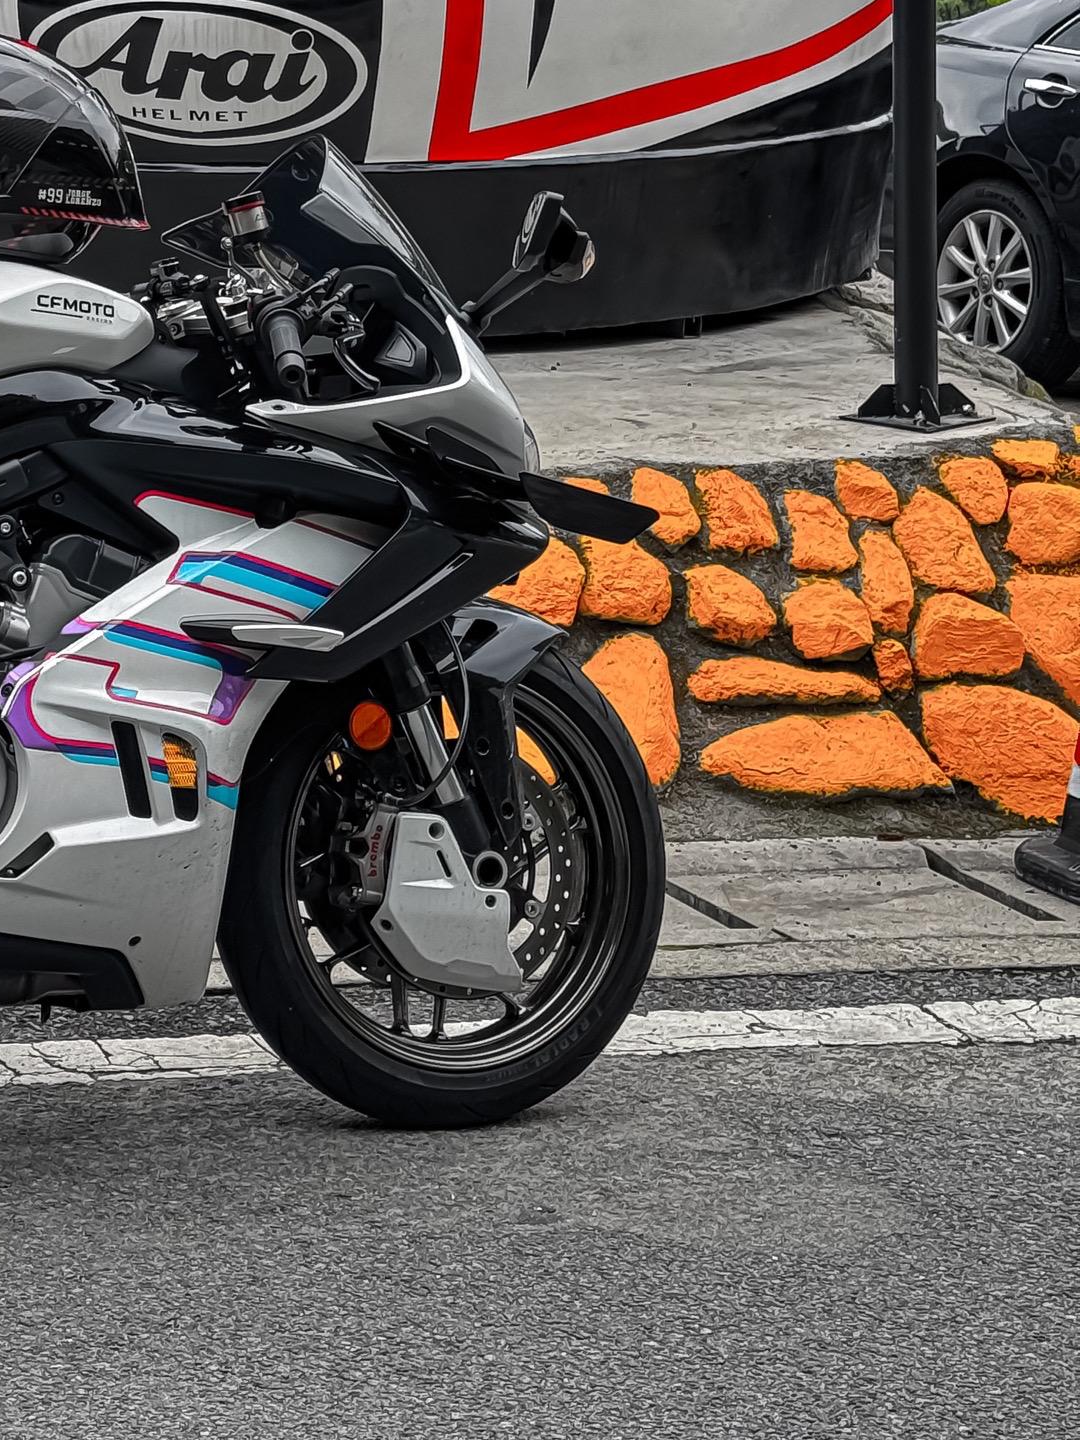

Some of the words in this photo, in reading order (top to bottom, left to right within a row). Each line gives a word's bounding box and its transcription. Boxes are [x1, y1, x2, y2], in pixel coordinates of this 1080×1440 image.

[84, 16, 318, 102] Arai
[132, 106, 249, 122] HELMET
[37, 294, 114, 318] CFMOTO
[367, 824, 383, 877] brembo
